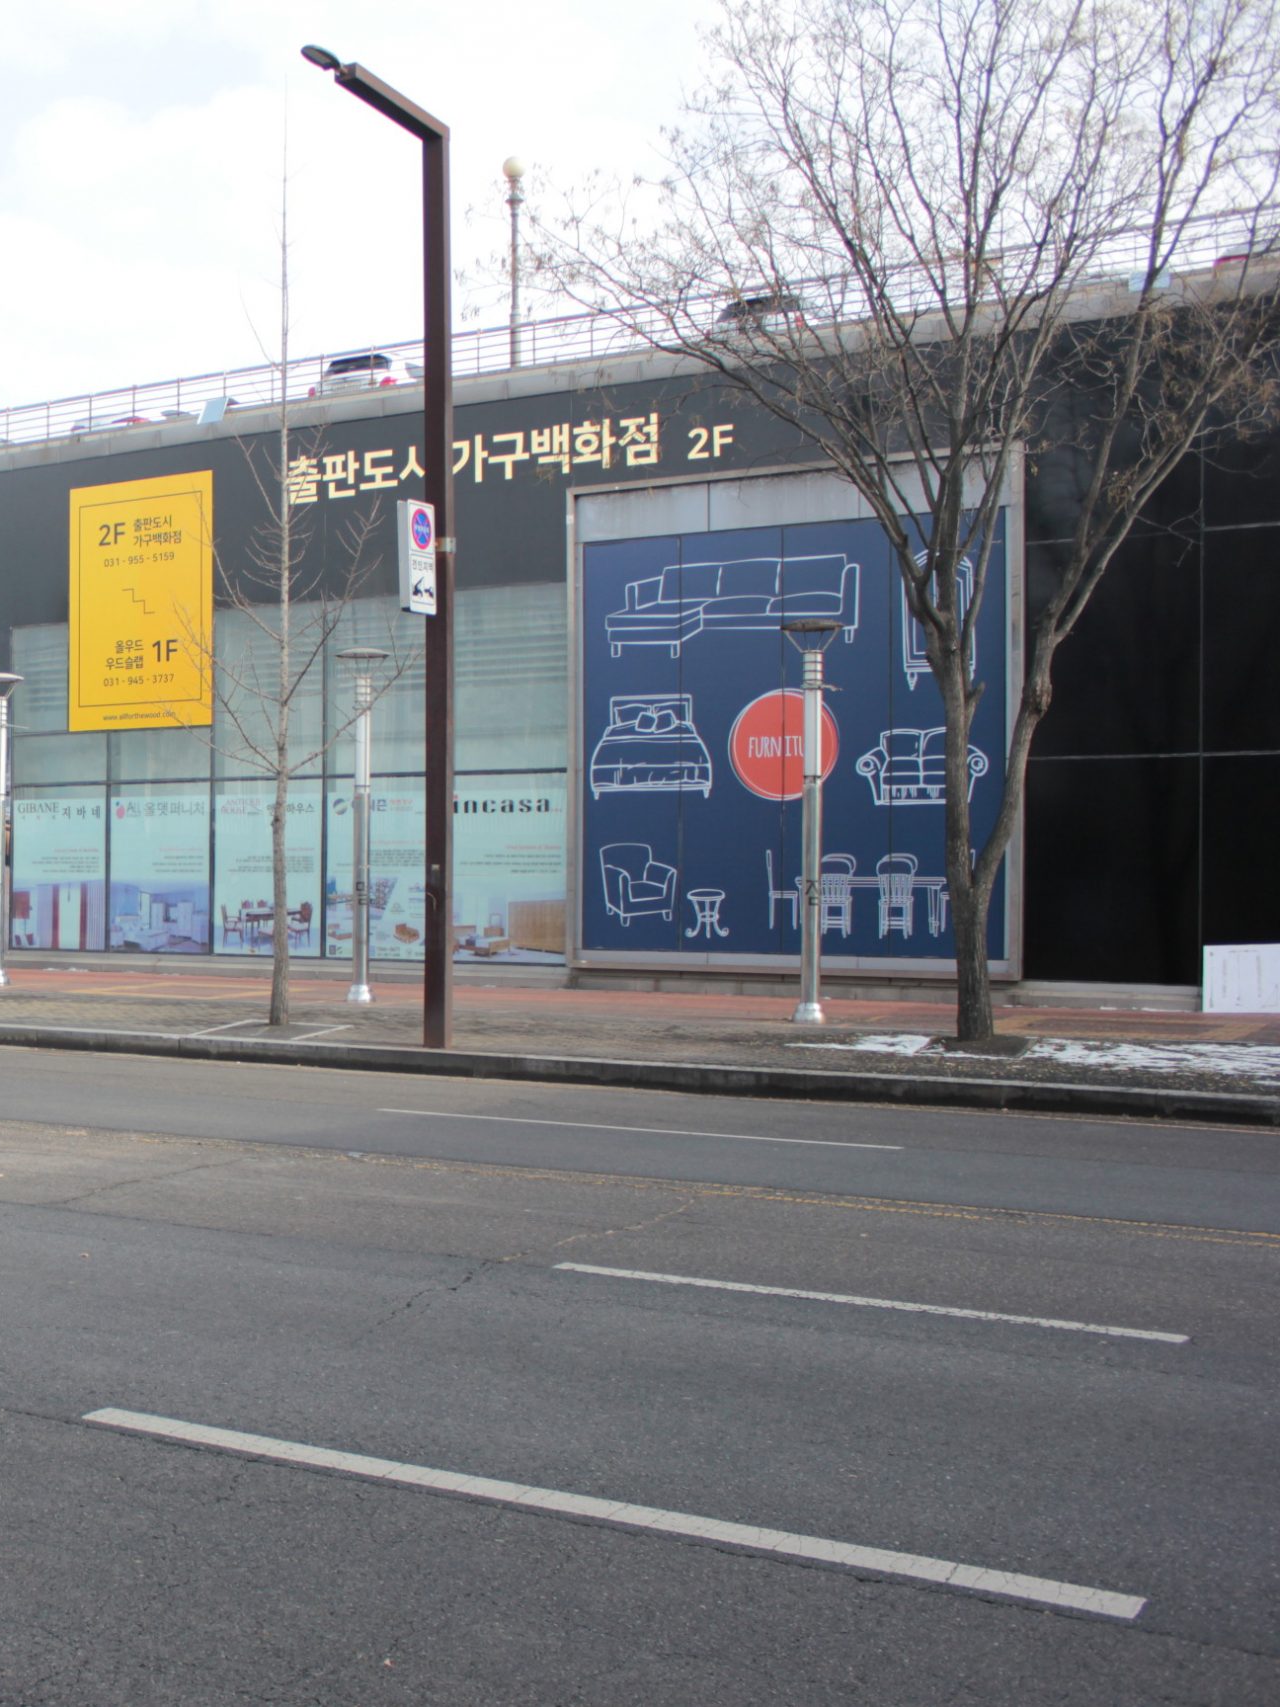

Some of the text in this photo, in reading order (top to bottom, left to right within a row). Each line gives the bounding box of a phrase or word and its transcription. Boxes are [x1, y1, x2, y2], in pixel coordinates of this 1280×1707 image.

[452, 411, 660, 484] 가구백화점
[686, 423, 735, 460] 2F
[132, 513, 173, 532] 출판도시
[97, 522, 127, 547] 2F
[132, 531, 183, 549] 가구백화점
[114, 638, 145, 654] 올우드
[151, 638, 179, 663] 1F
[104, 655, 145, 671] 우드슬랩
[748, 735, 805, 759] FURNITU
